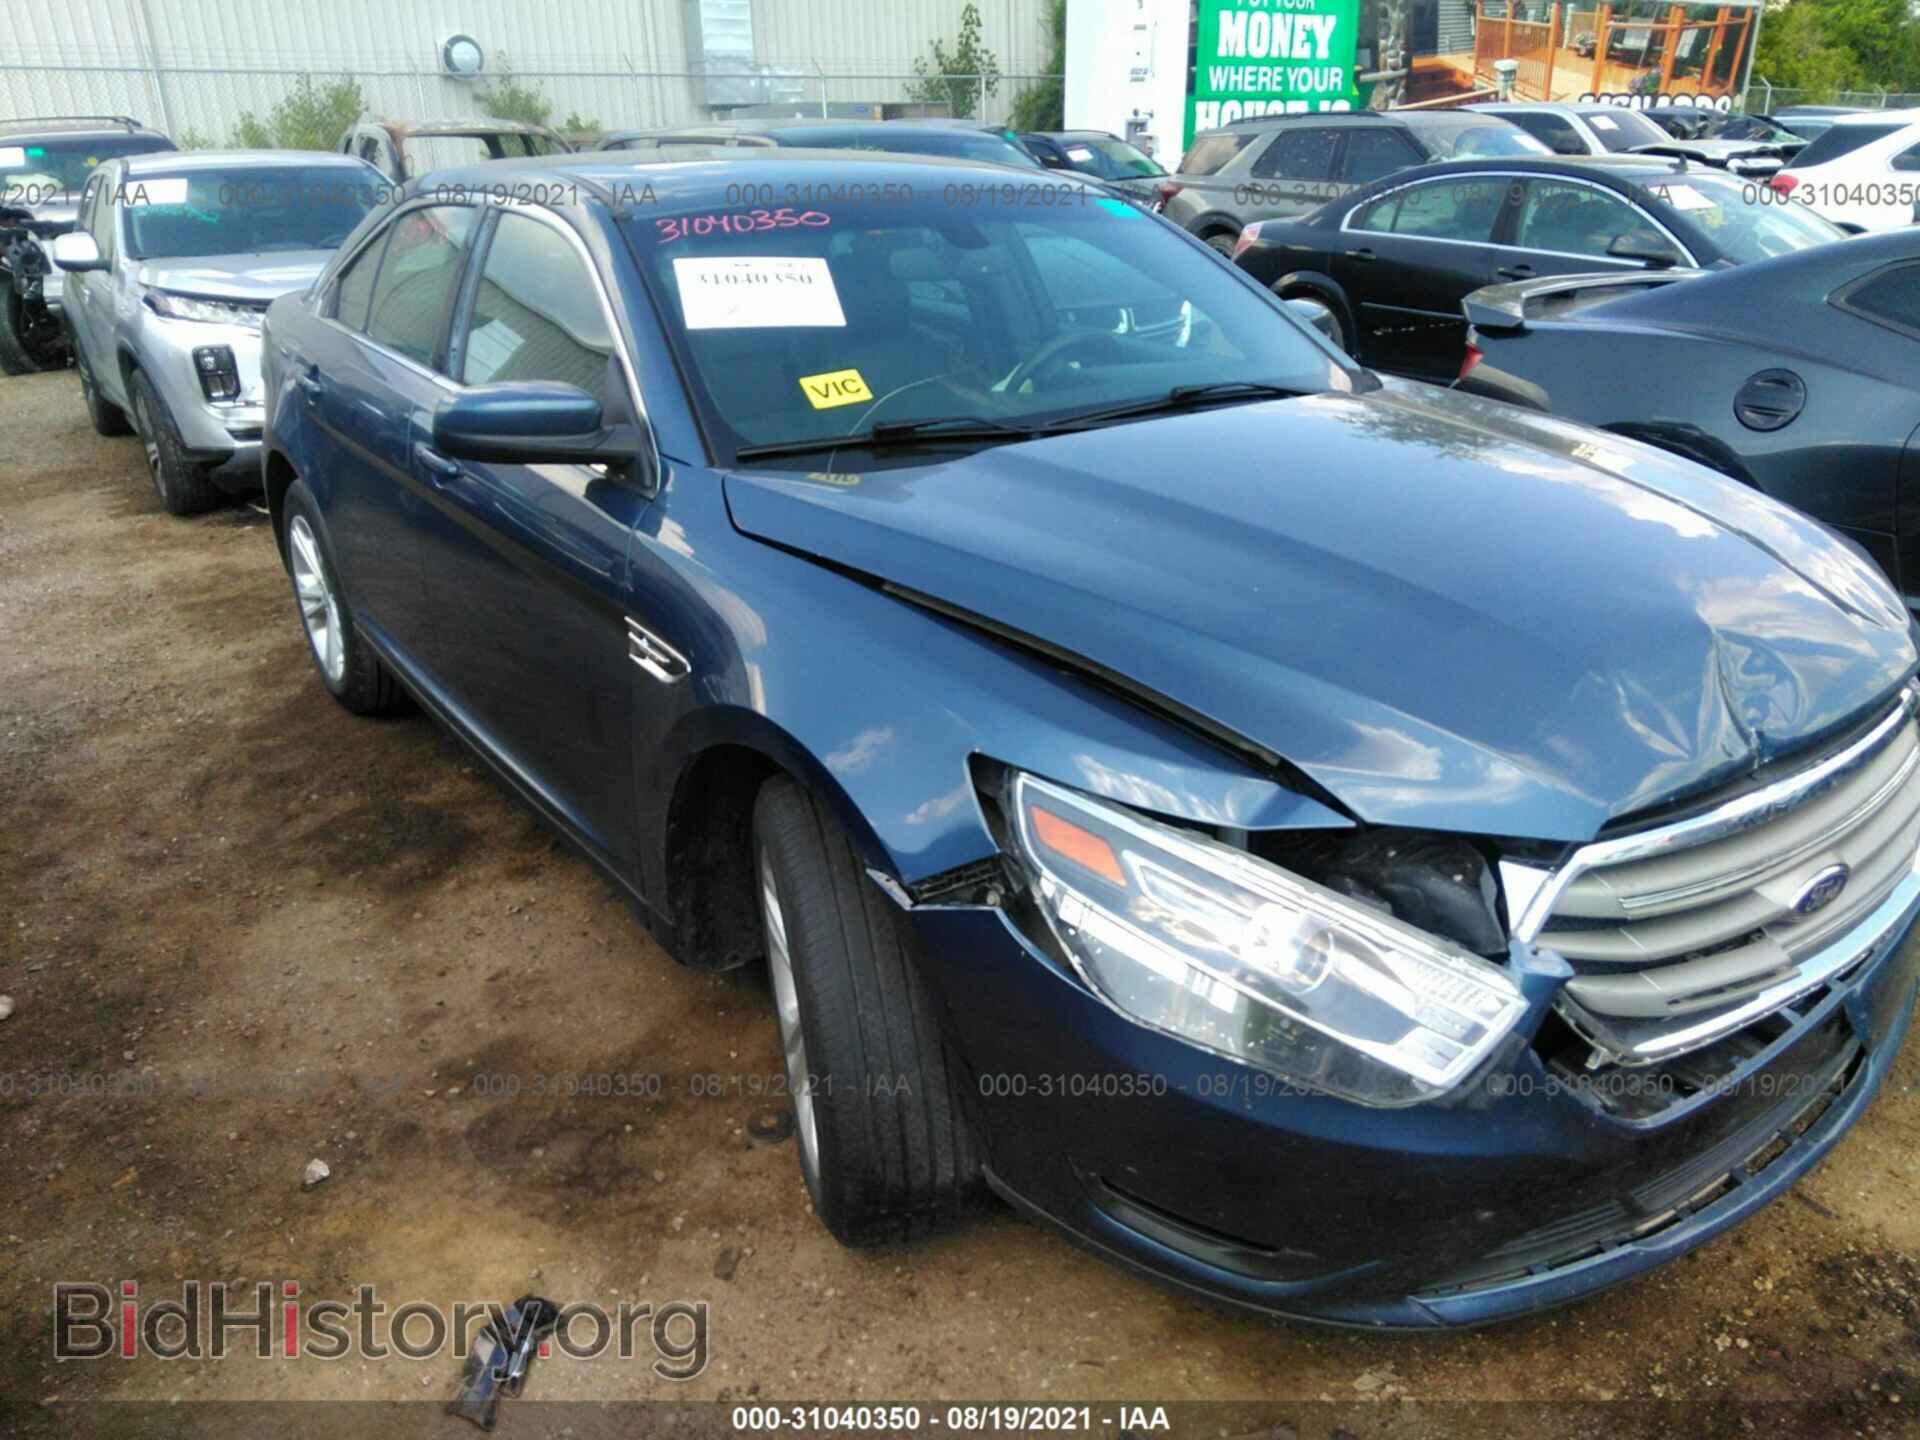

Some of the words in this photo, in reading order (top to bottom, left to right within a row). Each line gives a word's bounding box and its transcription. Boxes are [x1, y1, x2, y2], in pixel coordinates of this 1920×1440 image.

[1217, 10, 1336, 60] MONEY
[1208, 65, 1283, 92] WHERE
[1287, 66, 1343, 93] YOUR
[656, 208, 831, 244] 31040350
[810, 378, 861, 399] VIC
